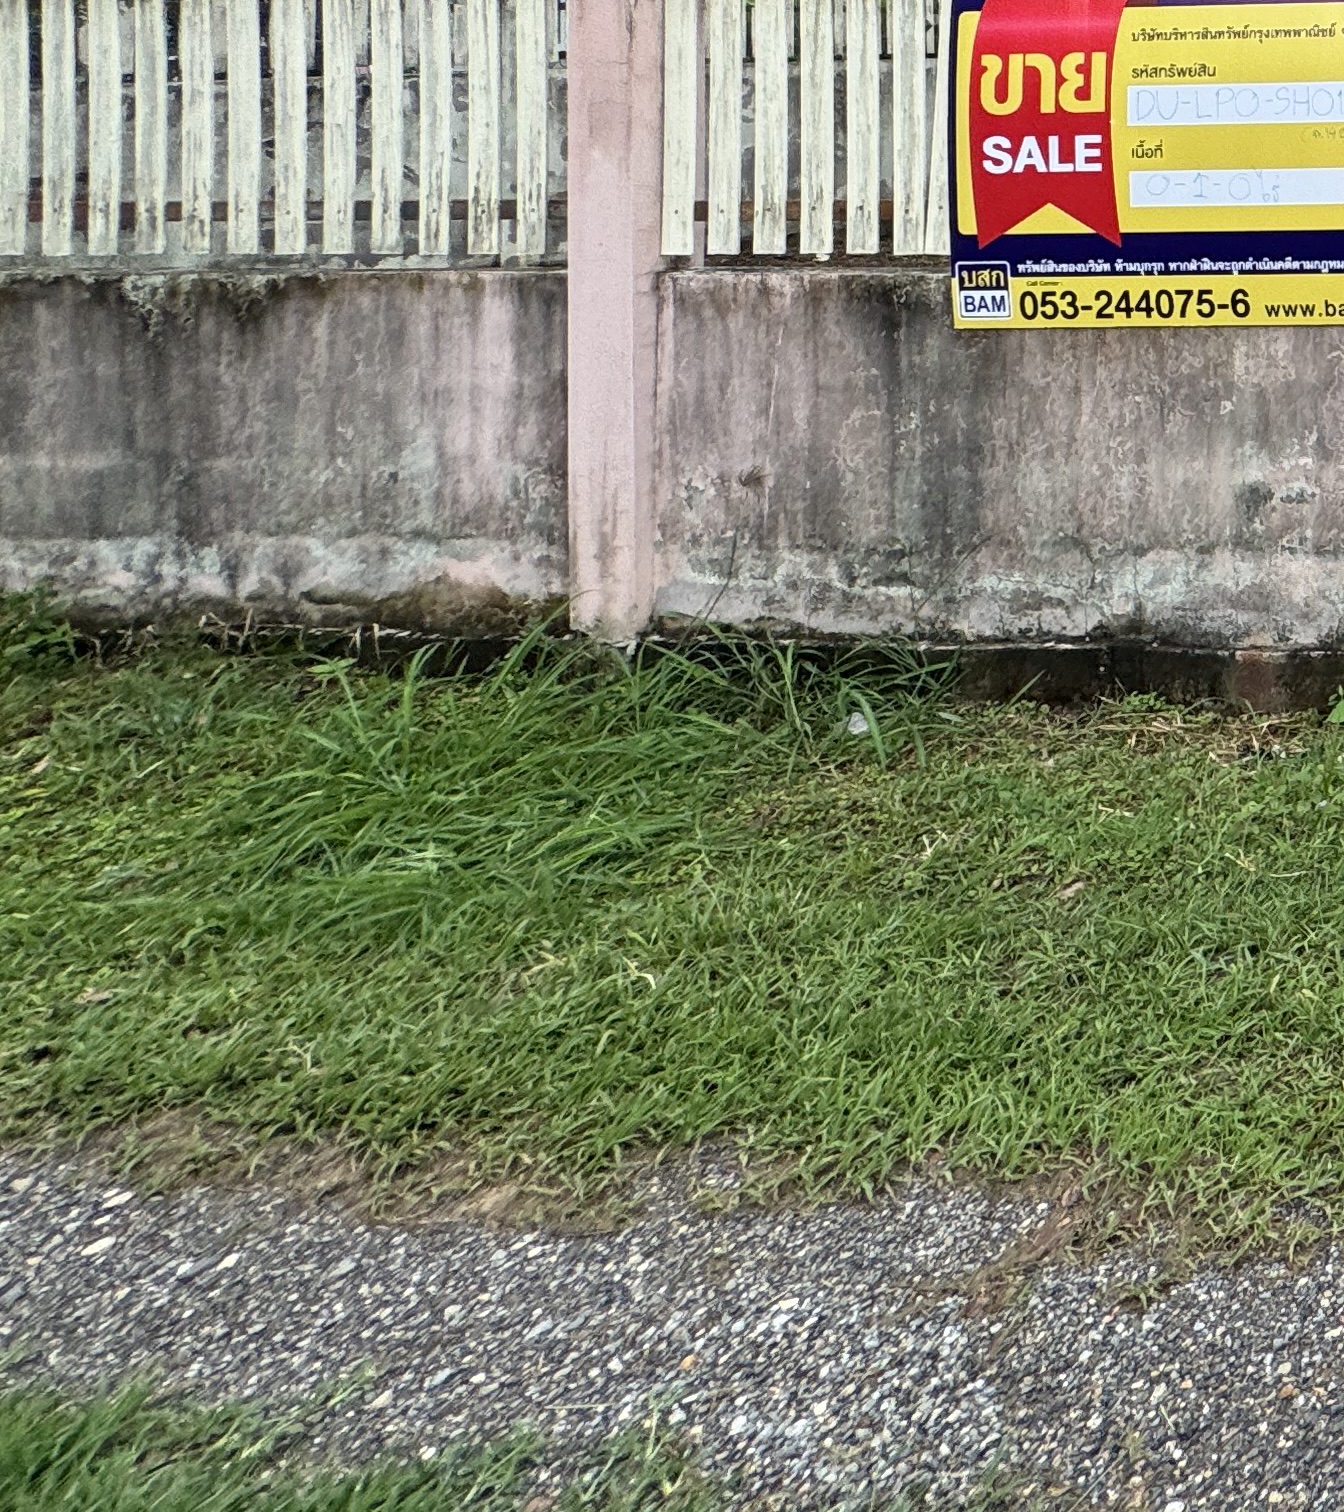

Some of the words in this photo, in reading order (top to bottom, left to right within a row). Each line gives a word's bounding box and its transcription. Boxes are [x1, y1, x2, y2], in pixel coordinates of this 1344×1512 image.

[980, 51, 1107, 116] ขาย
[982, 134, 1103, 175] SALE
[1131, 139, 1164, 158] เนื้อที่
[961, 267, 1005, 288] บสก
[1114, 258, 1165, 276] ห้ามบุกรุก
[963, 295, 1006, 313] BAM
[1019, 289, 1250, 320] 053-244075-6
